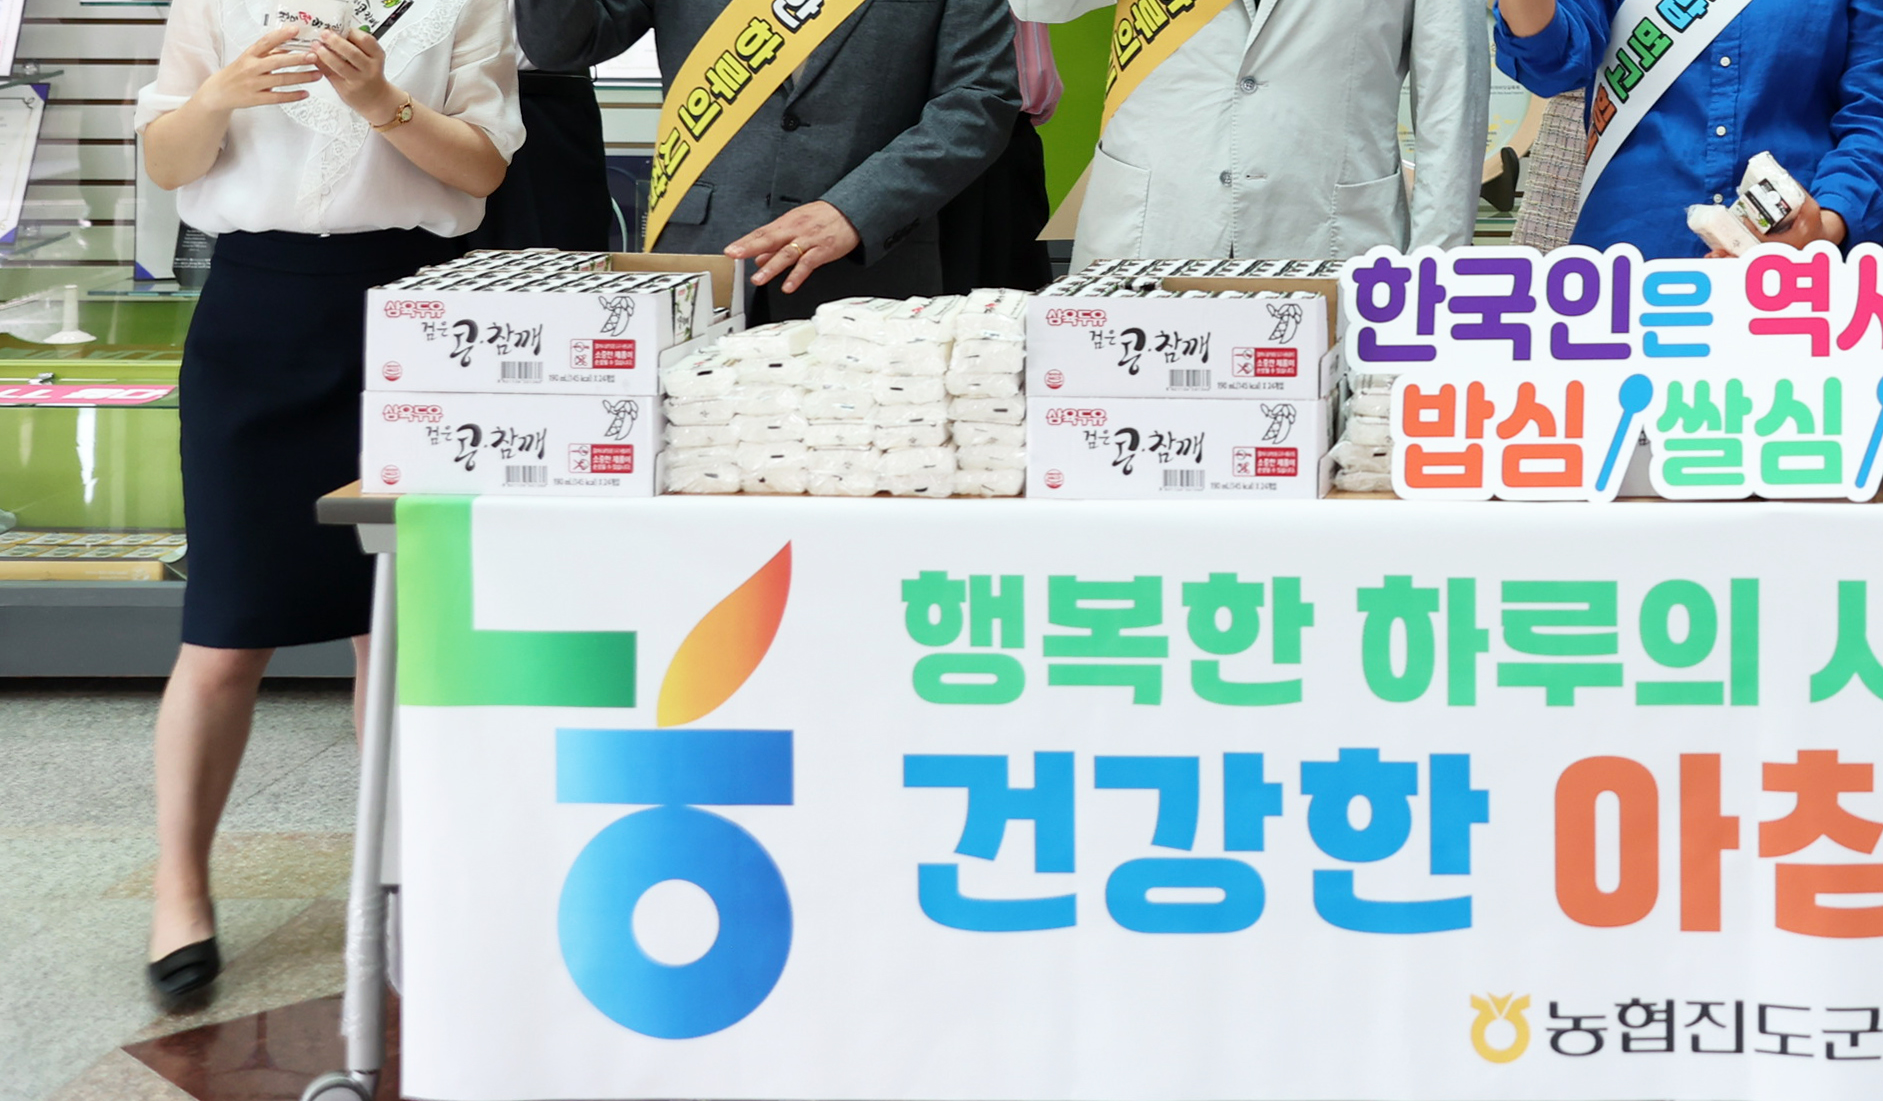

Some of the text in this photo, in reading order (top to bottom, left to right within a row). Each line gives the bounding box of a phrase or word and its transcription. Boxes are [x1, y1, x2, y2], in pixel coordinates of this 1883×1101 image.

[1603, 15, 1675, 104] 먹고
[677, 16, 785, 142] 하루의
[384, 300, 446, 318] 삼육두유
[1045, 308, 1107, 327] 삼육두유
[1351, 254, 1714, 363] 한국인은
[422, 321, 448, 341] 검은
[1090, 330, 1116, 350] 검은
[382, 404, 444, 423] 삼육두유
[1045, 408, 1107, 427] 삼육두유
[426, 426, 452, 445] 검은
[1083, 430, 1110, 450] 검은
[901, 568, 1316, 709] 행복한
[1355, 570, 1763, 709] 하루의
[902, 746, 1490, 935] 건강한
